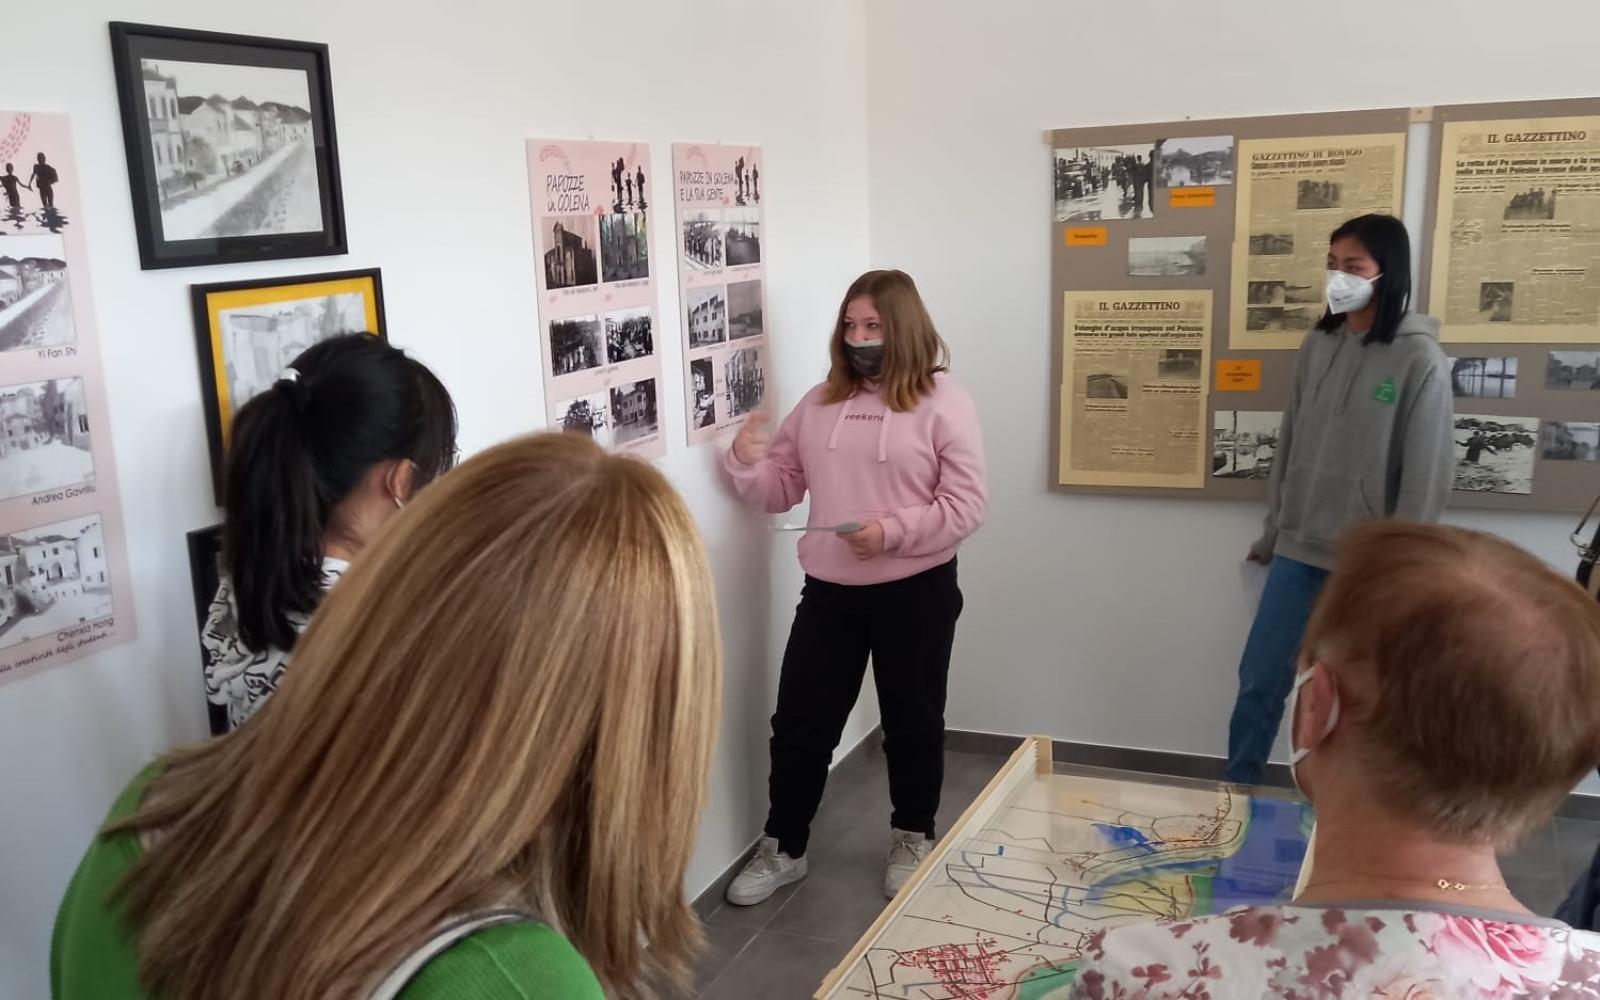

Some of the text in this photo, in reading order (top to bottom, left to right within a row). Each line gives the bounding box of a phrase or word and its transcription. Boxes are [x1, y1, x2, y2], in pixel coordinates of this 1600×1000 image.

[1487, 130, 1586, 144] IL GAZZETTINO
[1252, 148, 1362, 161] GAZZETTINO DI ROVIGO
[546, 174, 585, 192] PAPOZZE
[558, 193, 590, 212] GOLENA
[1099, 301, 1181, 311] IL GAZZETTINO
[47, 348, 64, 360] Fan
[32, 491, 64, 505] Andrea
